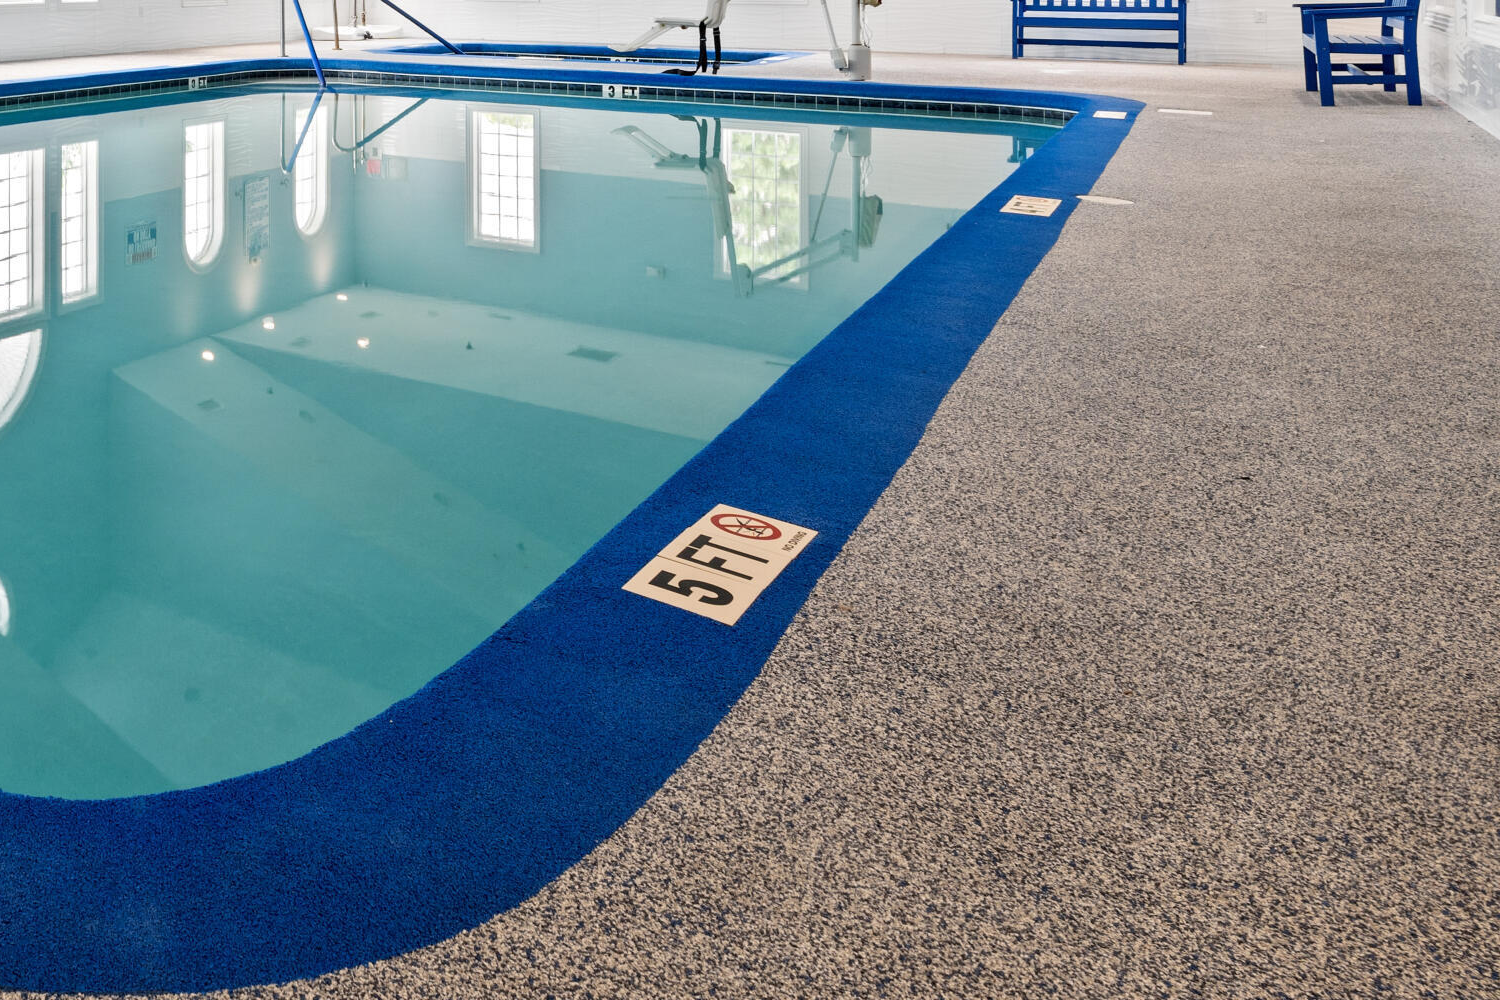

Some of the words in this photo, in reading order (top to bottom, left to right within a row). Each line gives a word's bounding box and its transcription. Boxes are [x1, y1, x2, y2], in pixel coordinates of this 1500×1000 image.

[781, 541, 795, 552] NO
[787, 531, 807, 546] DIVING
[676, 533, 770, 581] FT
[648, 569, 735, 606] 5
